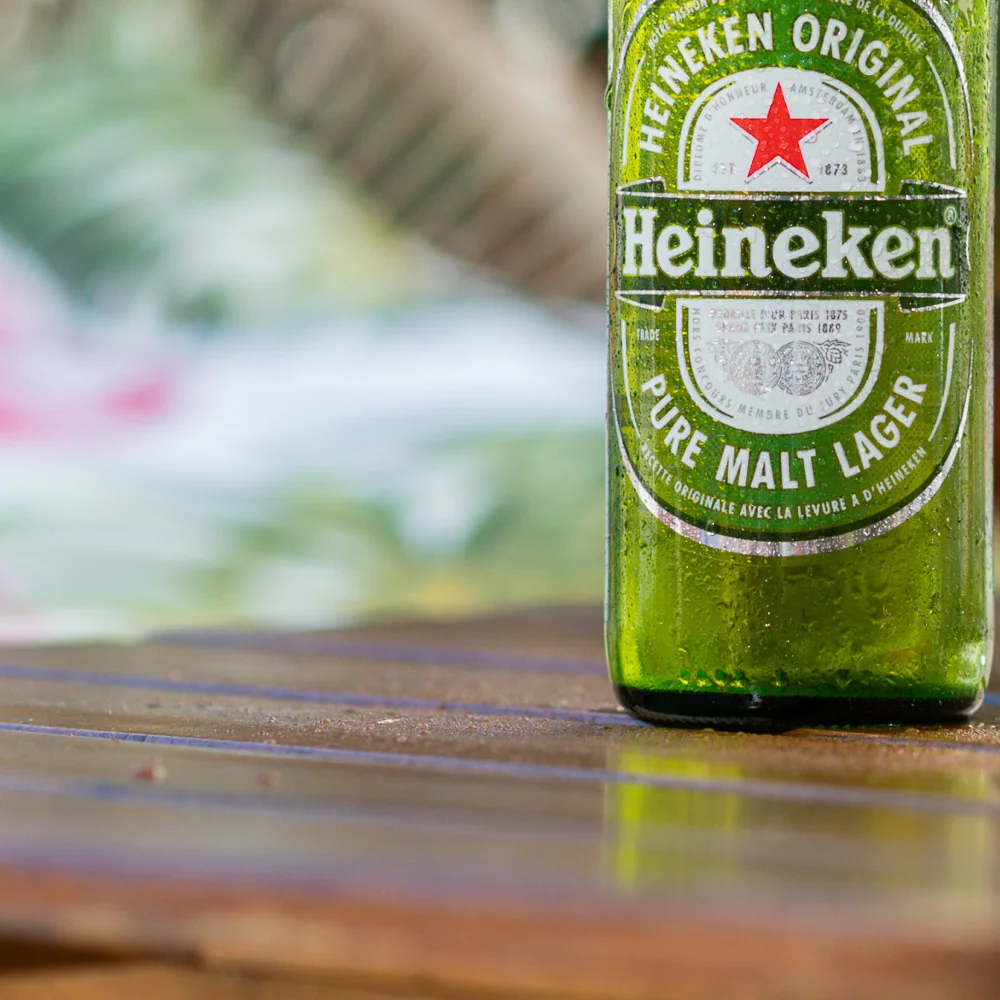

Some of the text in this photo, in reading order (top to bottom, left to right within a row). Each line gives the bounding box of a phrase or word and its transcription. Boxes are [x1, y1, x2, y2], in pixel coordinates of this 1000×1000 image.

[873, 5, 886, 20] LA
[639, 12, 934, 155] HEINEKEN ORIGINAL
[820, 163, 848, 175] 1873
[623, 207, 955, 279] Heineken
[791, 309, 819, 320] PRIS
[826, 309, 848, 320] 1875
[636, 328, 660, 341] TRADE
[782, 323, 811, 333] PAIS
[818, 323, 841, 333] 1889
[905, 331, 934, 344] MARK
[737, 404, 789, 420] MEMBRE
[796, 405, 812, 418] DU
[641, 374, 927, 490] PURE MALT LAGER
[674, 481, 735, 514] ORIGINALE
[740, 504, 771, 519] AVEC
[777, 506, 792, 519] LA
[798, 498, 846, 519] LEVURE
[863, 446, 927, 502] D'HEINEKEN
